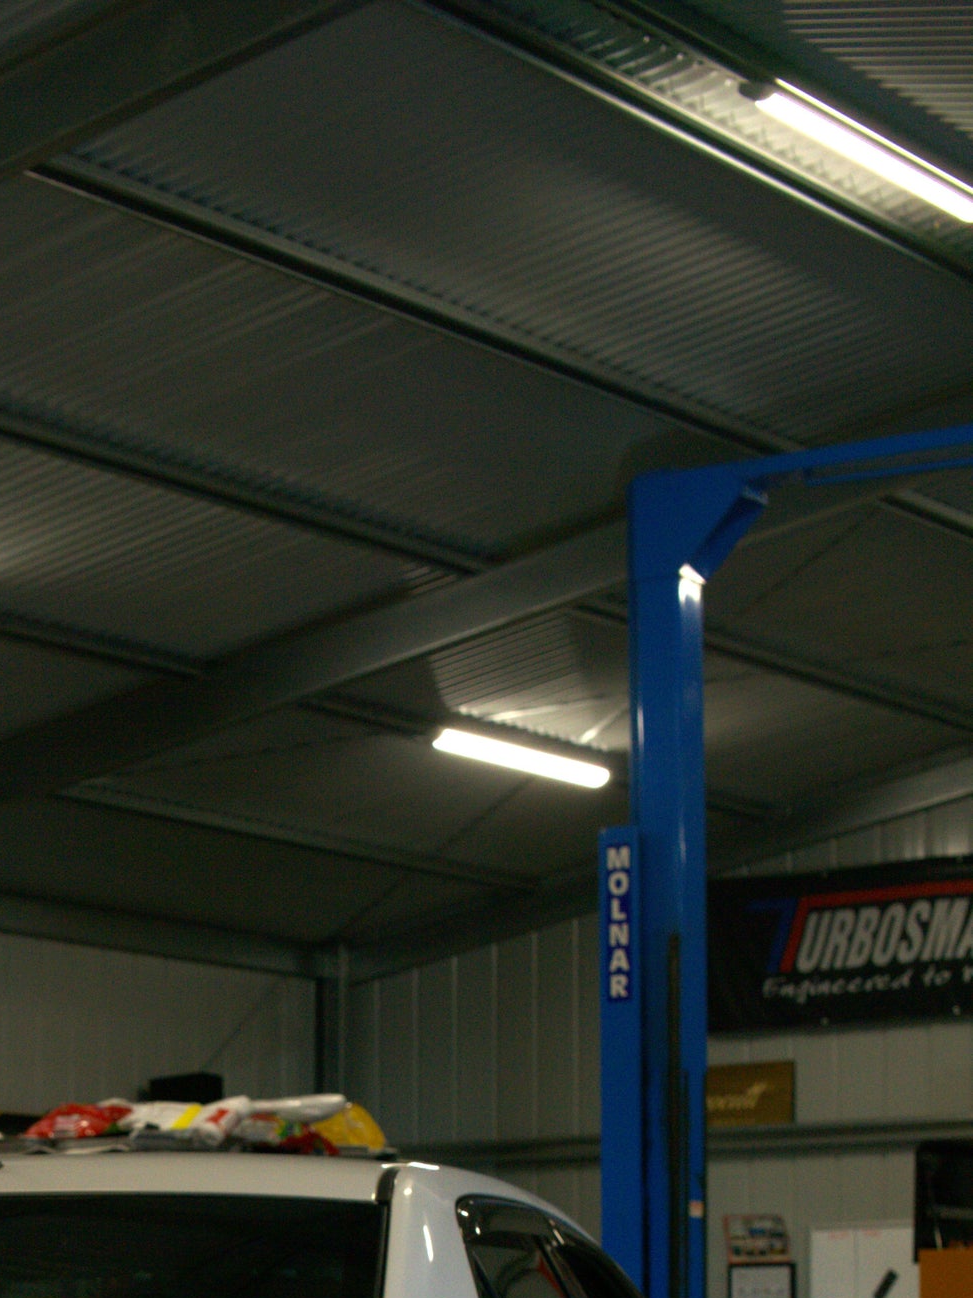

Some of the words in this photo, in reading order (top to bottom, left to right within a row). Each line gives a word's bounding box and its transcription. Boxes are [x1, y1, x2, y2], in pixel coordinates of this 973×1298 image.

[606, 846, 632, 999] MOLNAR
[762, 970, 913, 1004] Engineered
[922, 963, 952, 987] to
